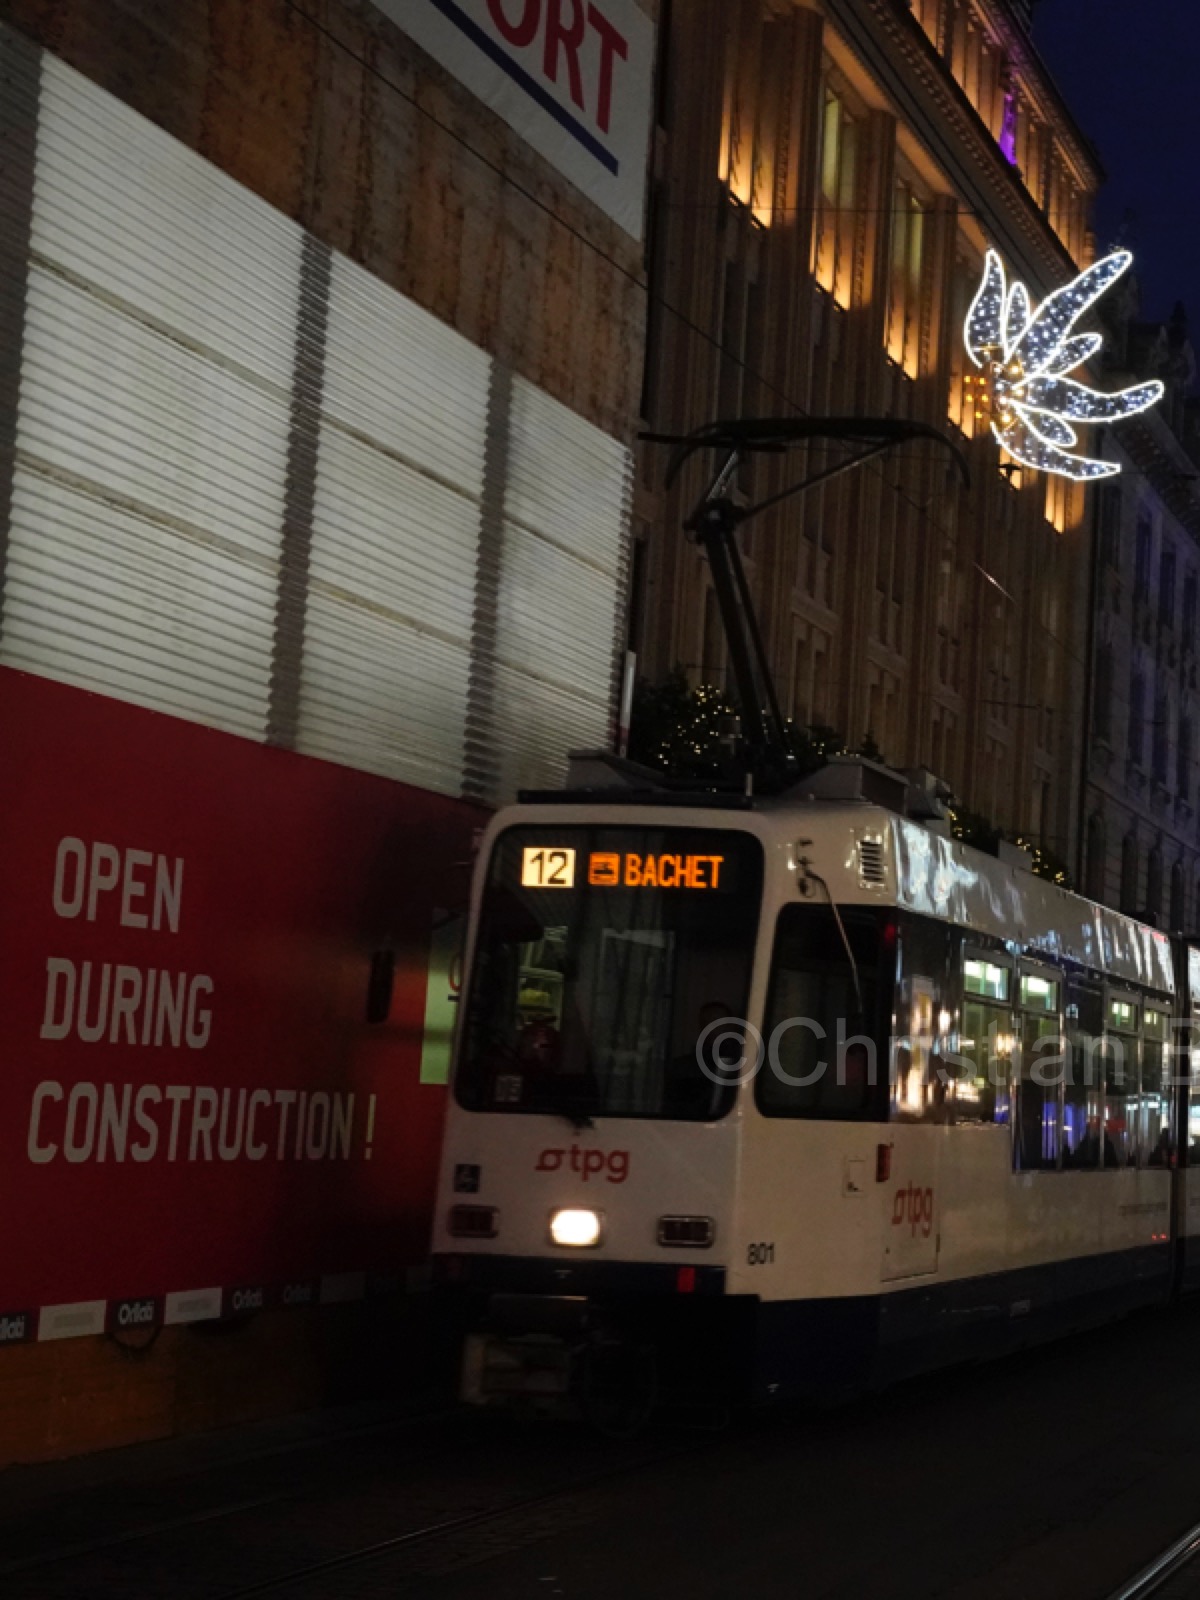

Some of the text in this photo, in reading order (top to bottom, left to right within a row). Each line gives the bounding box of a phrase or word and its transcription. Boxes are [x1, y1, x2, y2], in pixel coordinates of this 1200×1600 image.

[52, 836, 185, 934] OPEN
[530, 851, 724, 888] 12 BACHET
[40, 956, 215, 1049] DURING
[747, 1242, 775, 1265] 801
